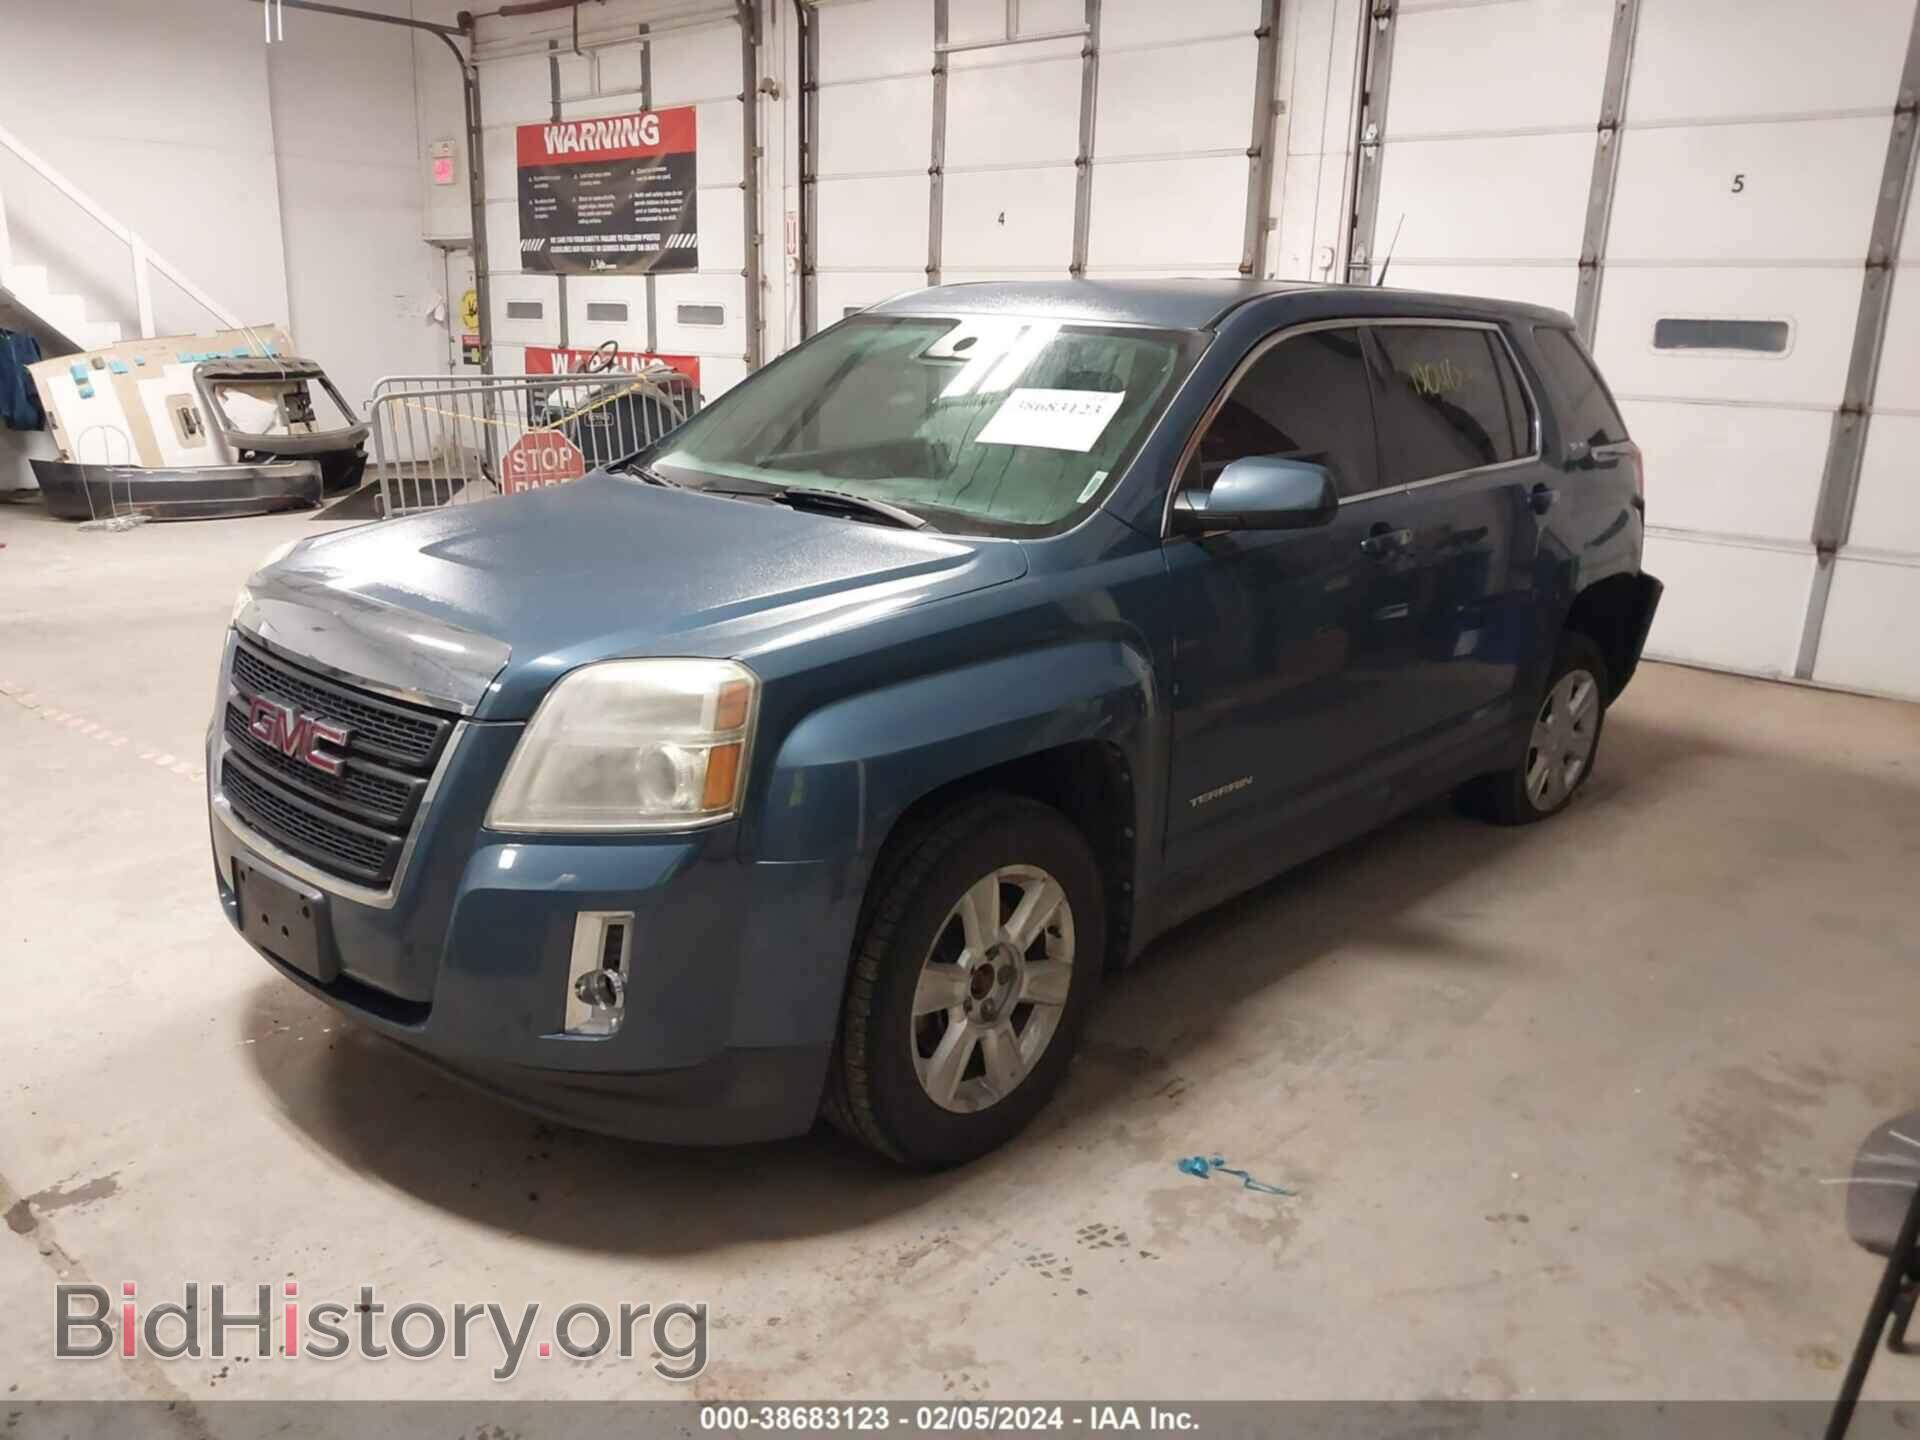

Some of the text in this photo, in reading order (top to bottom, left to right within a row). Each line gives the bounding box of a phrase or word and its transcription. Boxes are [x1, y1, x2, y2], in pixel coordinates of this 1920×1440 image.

[544, 114, 660, 155] WARNING
[1731, 174, 1745, 193] 5
[998, 211, 1005, 226] 4
[513, 446, 573, 472] STOP
[248, 693, 350, 777] GMC
[1189, 775, 1254, 808] TERRAIN
